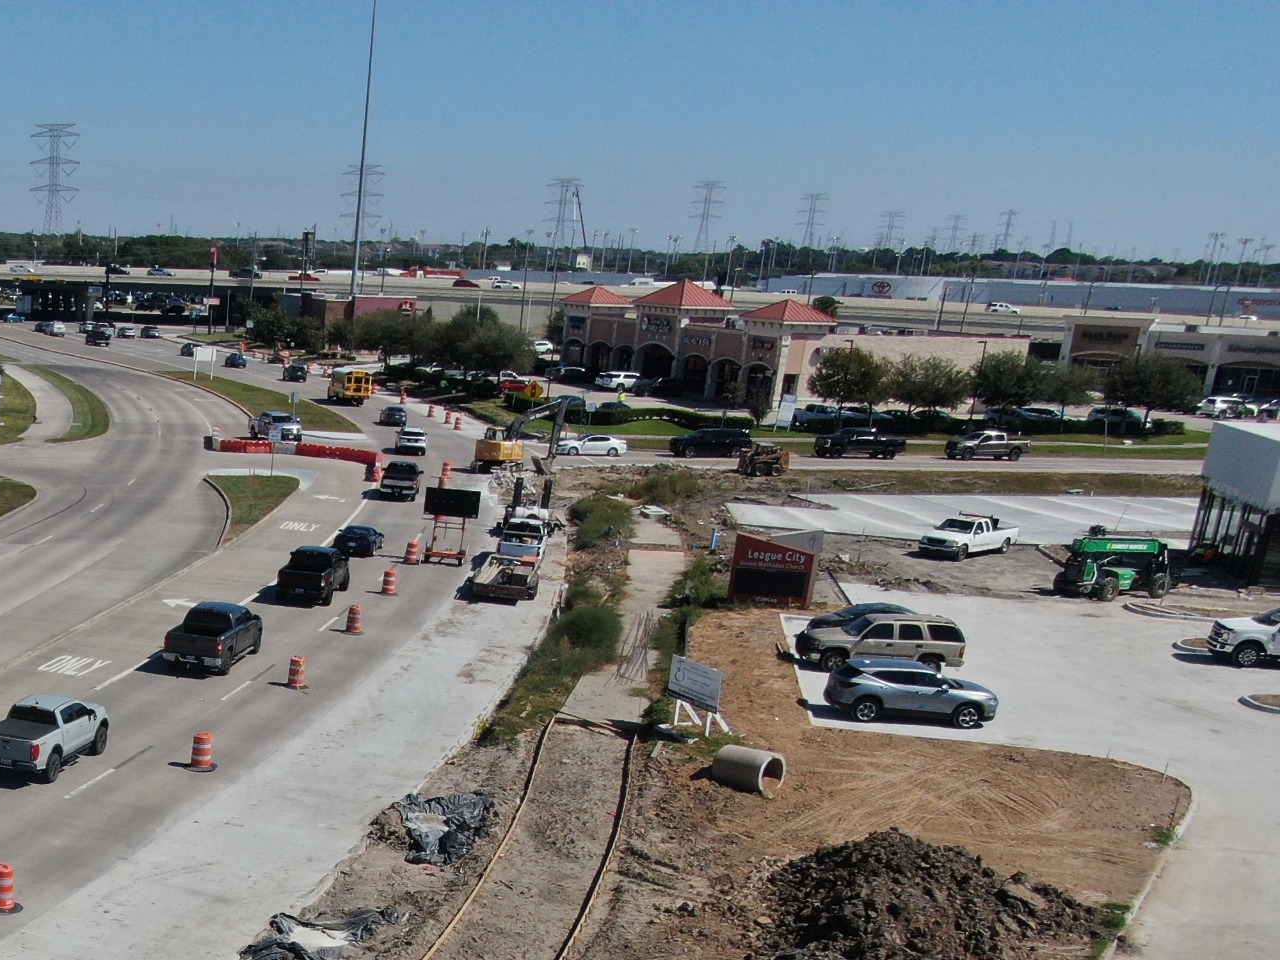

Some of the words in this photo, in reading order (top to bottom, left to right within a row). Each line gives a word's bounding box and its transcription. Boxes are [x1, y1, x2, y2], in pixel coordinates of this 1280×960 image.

[279, 521, 320, 532] ONLY
[748, 549, 782, 561] League
[785, 551, 806, 563] City
[757, 561, 785, 569] Methodist
[38, 655, 112, 676] ONLY
